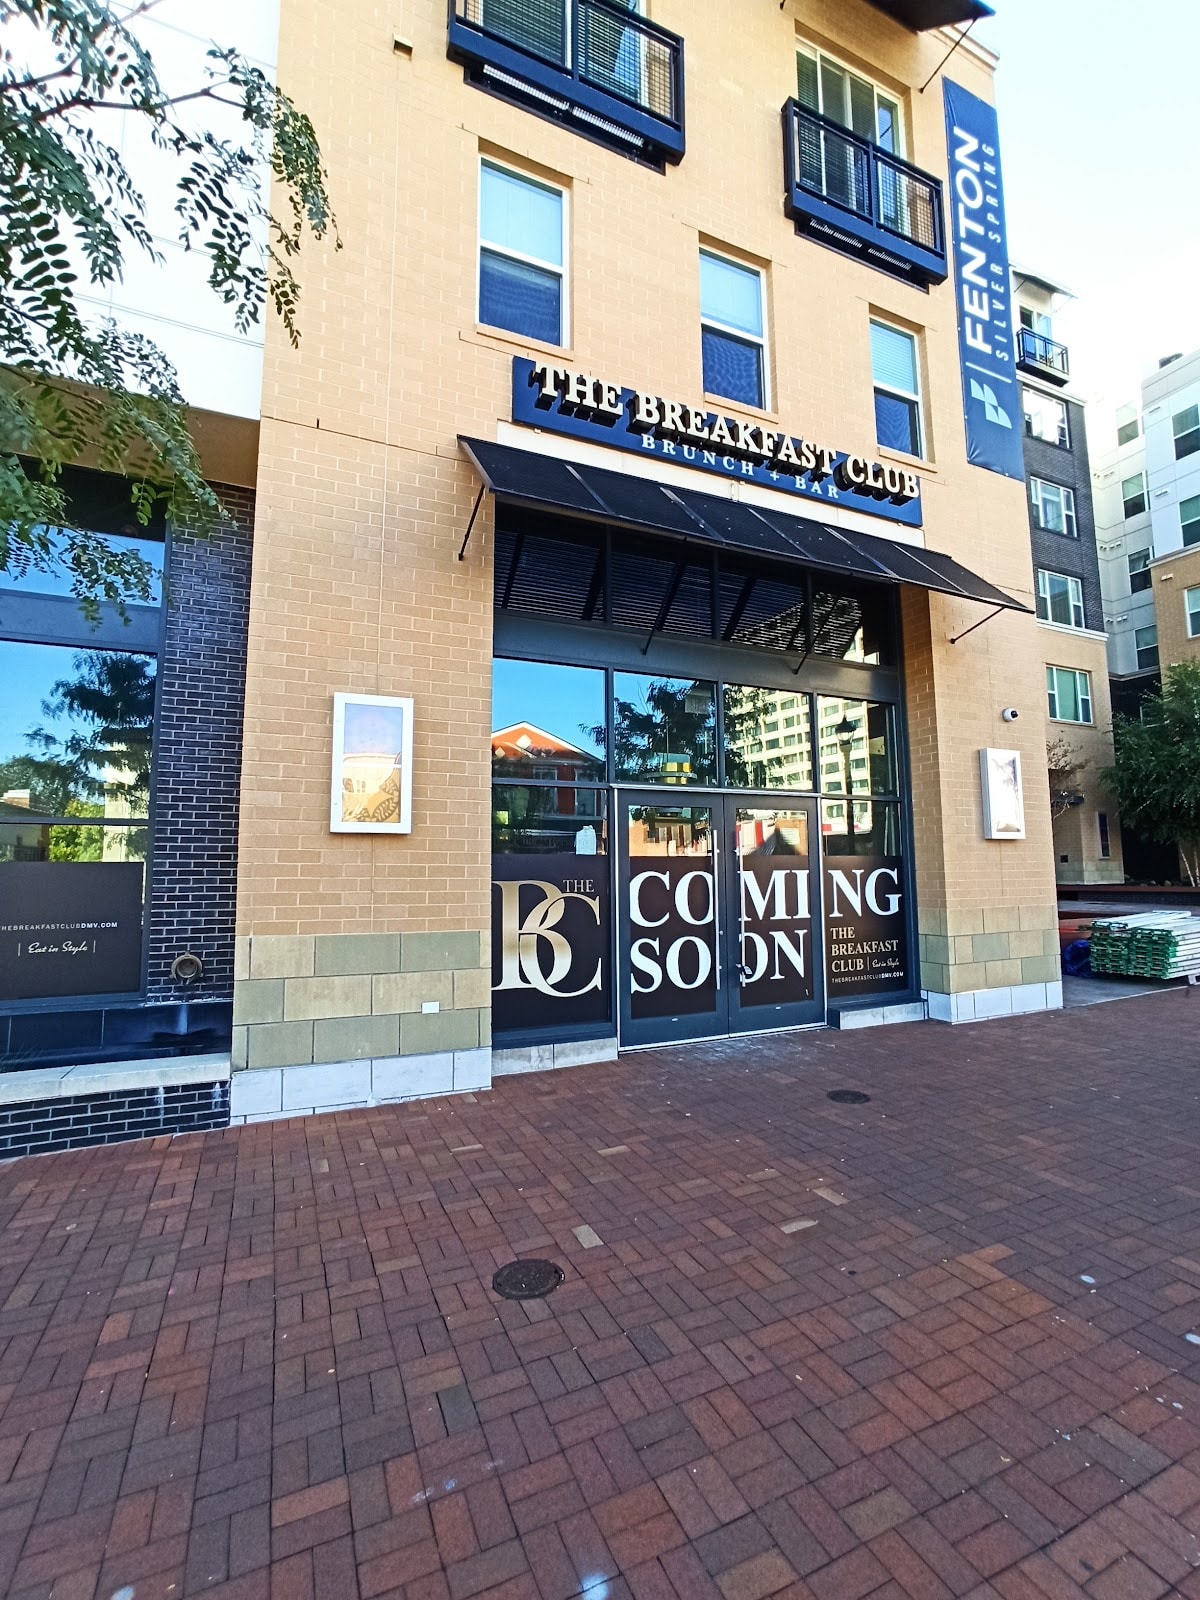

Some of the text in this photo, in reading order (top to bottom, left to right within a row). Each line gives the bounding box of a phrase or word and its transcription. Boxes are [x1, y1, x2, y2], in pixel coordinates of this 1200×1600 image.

[953, 126, 993, 355] FENTON
[981, 143, 1009, 363] SILVER SPRING
[534, 362, 920, 498] THE BREAKFAST CLUB
[641, 434, 754, 476] BRUNCH
[795, 475, 839, 499] BAR
[562, 879, 594, 893] THE
[0, 922, 118, 931] HEBREAKFASTCLUBDMV.COM
[830, 926, 855, 940] THE
[28, 940, 88, 955] Eat in Style
[831, 939, 899, 956] BREAKFAST
[831, 958, 864, 972] CLUB
